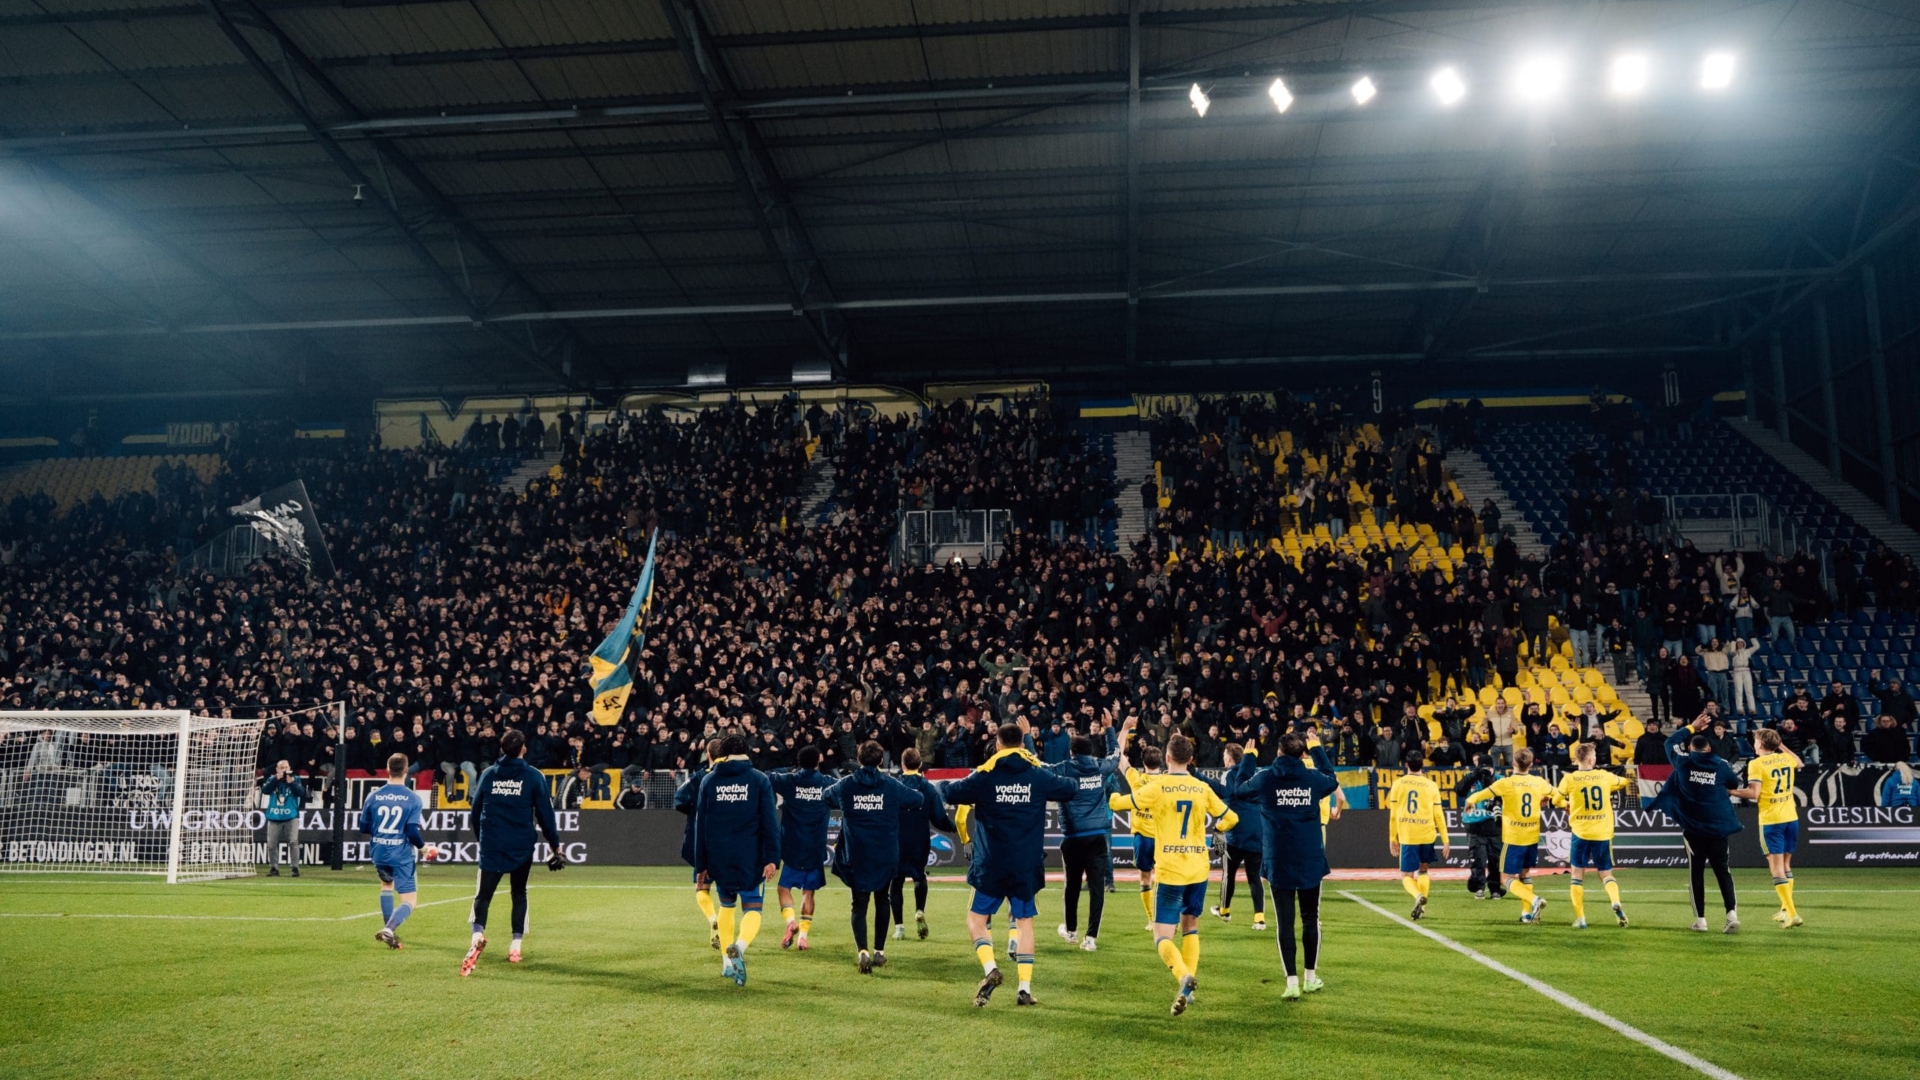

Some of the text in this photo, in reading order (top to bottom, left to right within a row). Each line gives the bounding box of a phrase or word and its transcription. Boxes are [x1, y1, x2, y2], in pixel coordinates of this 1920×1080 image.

[1372, 378, 1383, 414] 9
[167, 421, 215, 447] VOOR
[492, 779, 523, 788] voetbal
[1771, 766, 1791, 794] 27
[491, 787, 522, 796] shop.nl
[716, 783, 749, 793] voetbal
[795, 786, 823, 794] voetbal
[995, 783, 1032, 793] voetbal
[1276, 787, 1312, 797] voetbal
[716, 792, 748, 803] shop.nl
[795, 792, 822, 801] shop.nl
[853, 793, 884, 802] voetbal
[995, 792, 1031, 805] shop.nl
[1276, 796, 1311, 808] shop.nl
[1407, 790, 1418, 814] 6
[1580, 785, 1603, 811] 19
[269, 807, 291, 815] FOTO
[853, 801, 884, 812] shop.nl
[1521, 792, 1532, 818] 8
[129, 810, 173, 830] UW
[377, 805, 403, 834] 22
[1176, 800, 1192, 839] 7
[1807, 806, 1914, 824] GIESING
[8, 840, 138, 863] BETONDINGEN.NL
[191, 842, 324, 865] BETONDINE.NL
[1163, 845, 1206, 854] EFFEKTIEF
